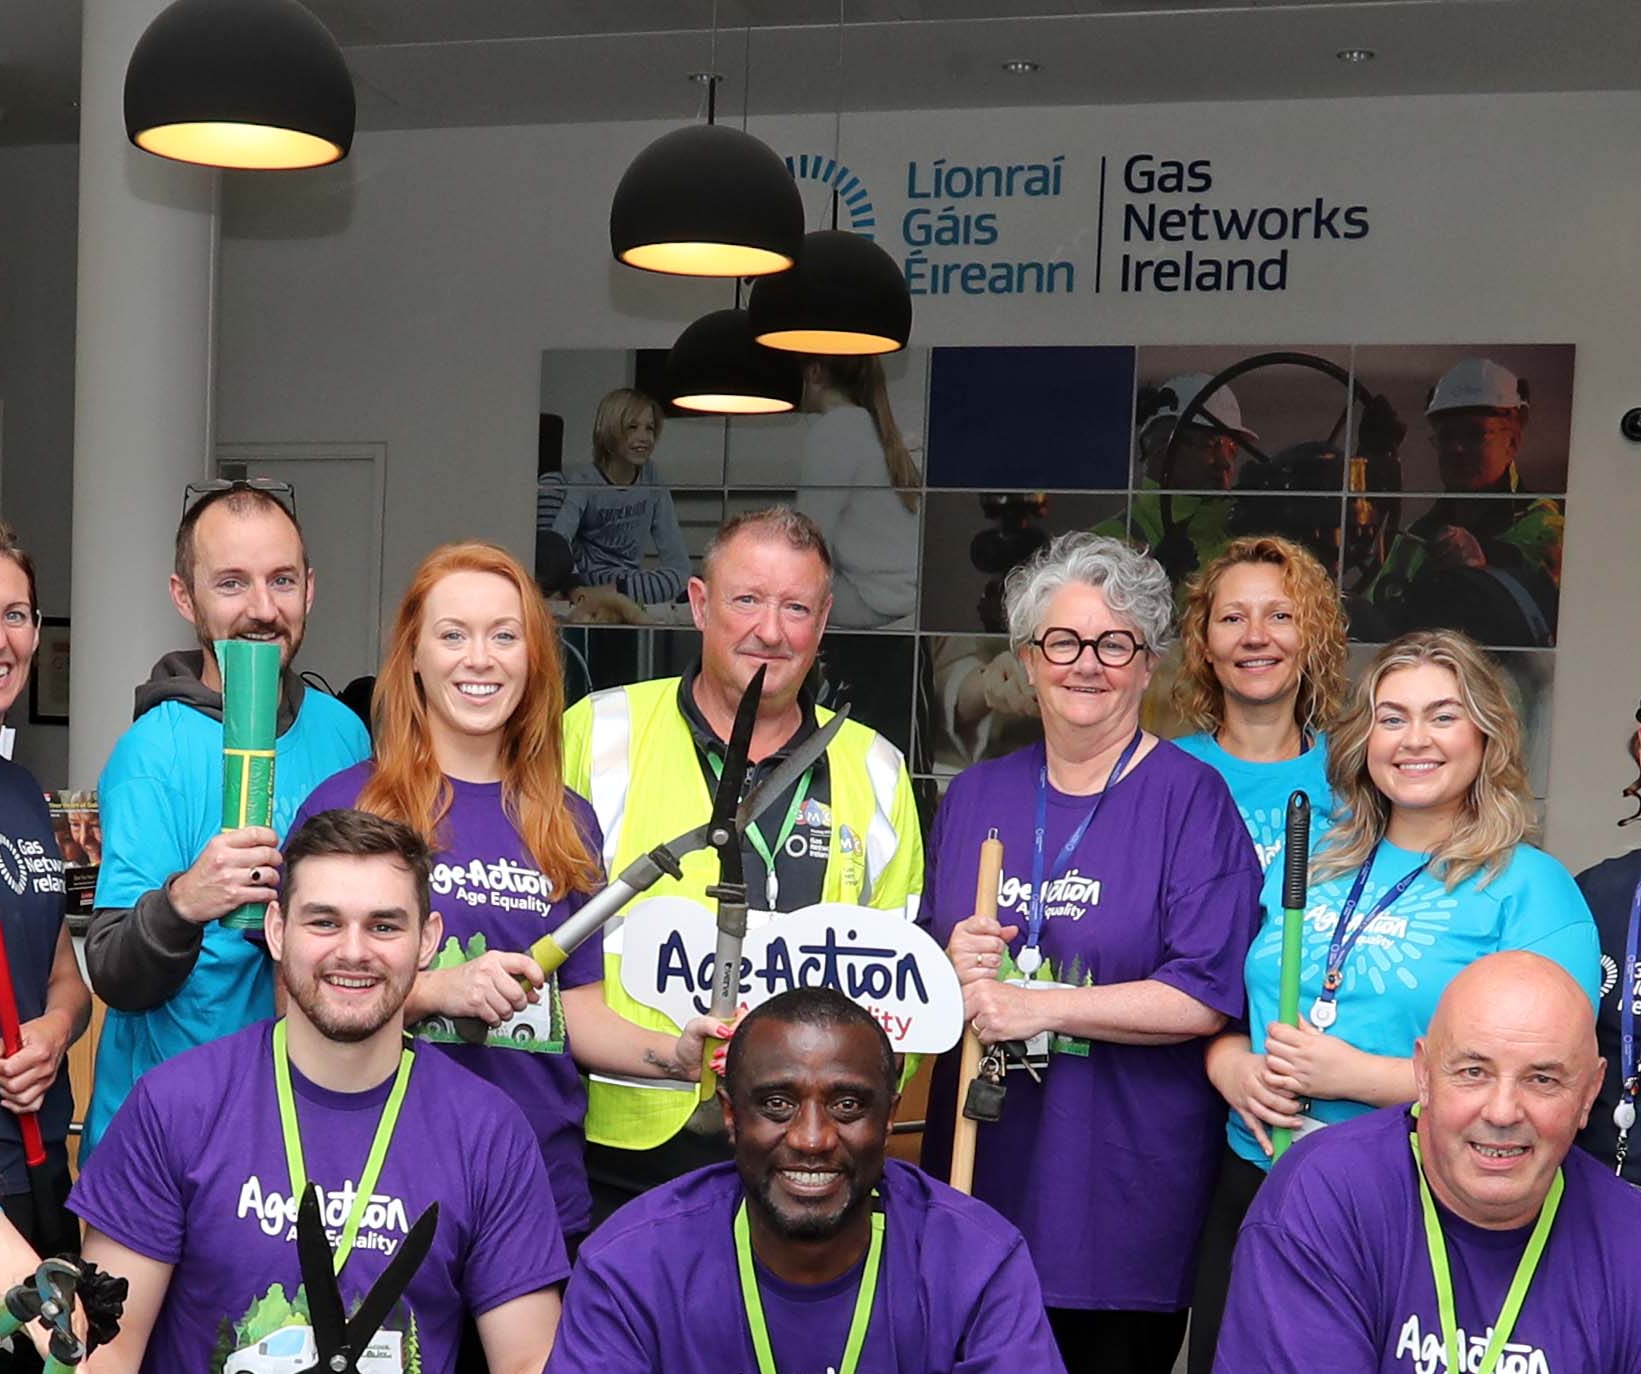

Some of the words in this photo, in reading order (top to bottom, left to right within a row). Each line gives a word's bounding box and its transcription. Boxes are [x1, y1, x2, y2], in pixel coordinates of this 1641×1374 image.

[907, 155, 1065, 199] Líonraí
[1123, 154, 1213, 194] Gas
[1122, 197, 1370, 242] Networks
[904, 249, 1074, 295] Éireann
[1121, 249, 1289, 292] Ireland
[17, 838, 44, 856] Gas
[456, 886, 487, 906] Age
[490, 892, 552, 917] Equality
